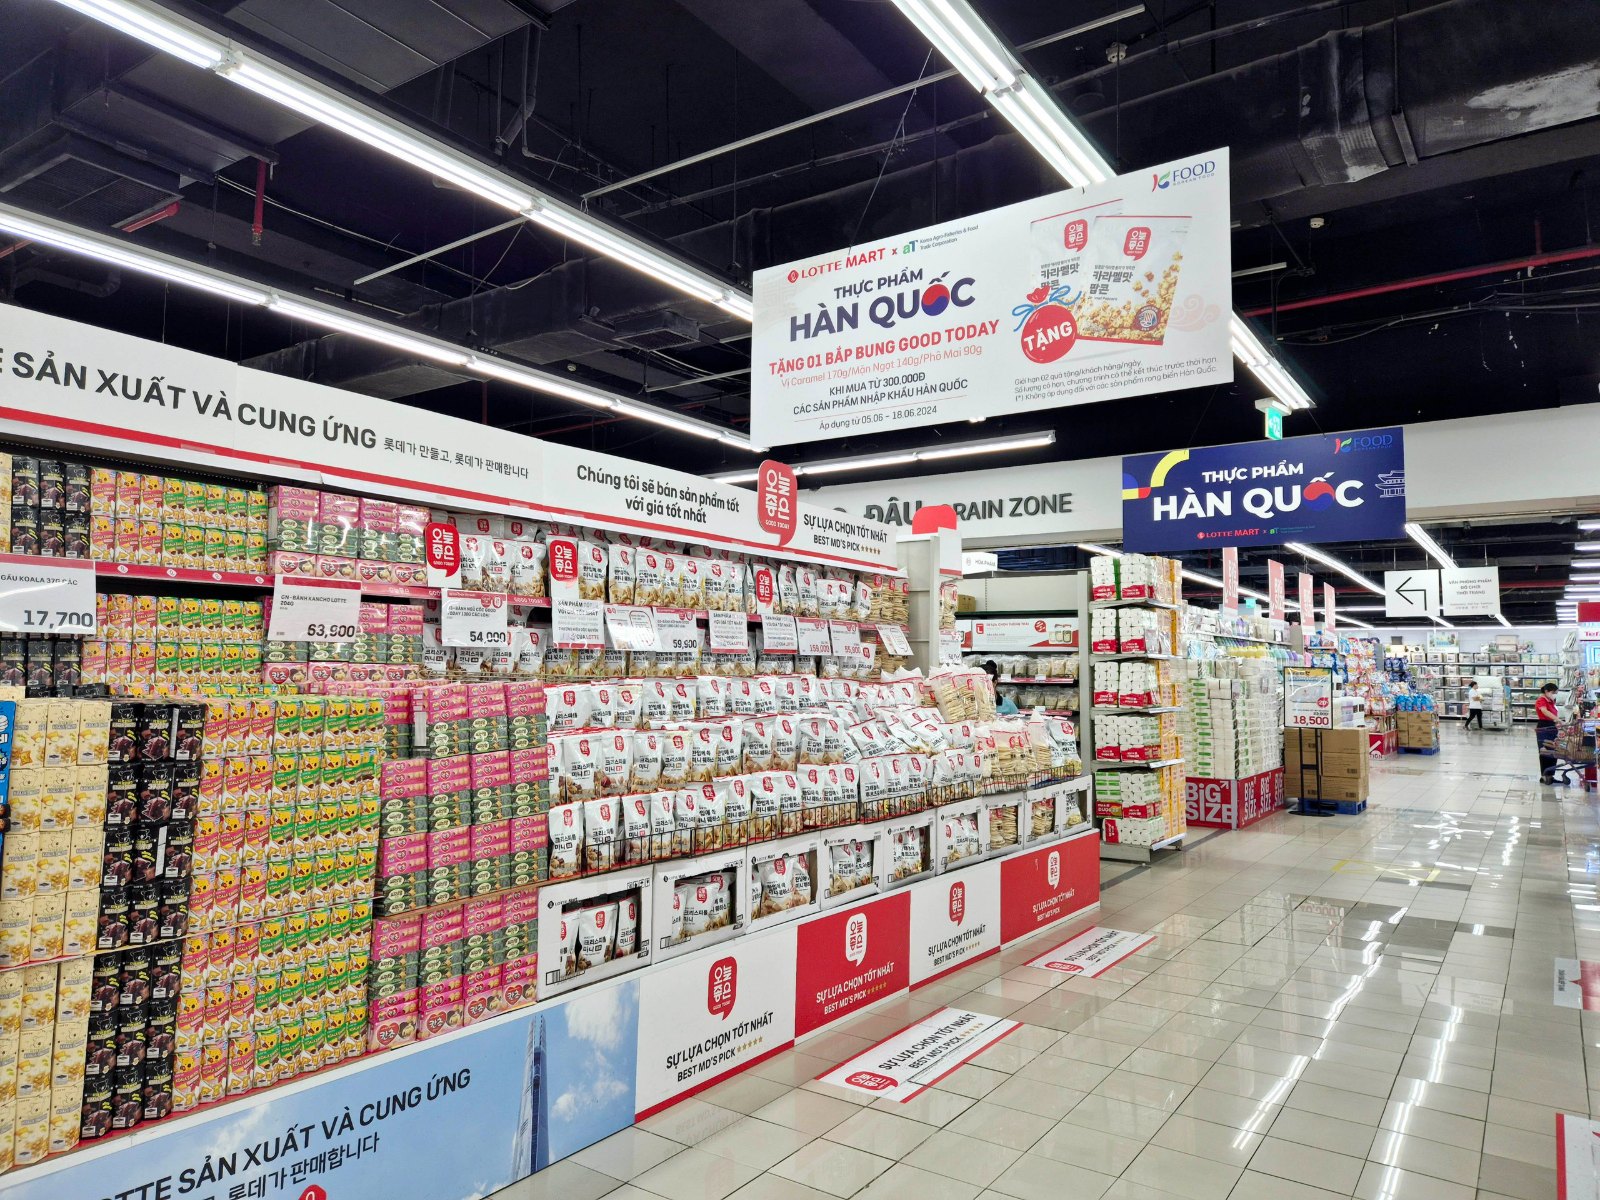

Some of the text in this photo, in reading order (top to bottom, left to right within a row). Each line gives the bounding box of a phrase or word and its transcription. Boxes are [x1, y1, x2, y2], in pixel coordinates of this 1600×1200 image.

[801, 261, 842, 279] LOTTE
[845, 248, 886, 268] MART
[968, 224, 979, 232] Food
[834, 267, 923, 299] THỰC PHẨM
[1093, 271, 1133, 282] 카라멜맛
[790, 270, 976, 342] HÀN QUỐC
[769, 320, 999, 377] TẶNG 01 BẮP BUNG GOOD TODAY
[1024, 322, 1073, 351] TẶNG
[781, 379, 790, 389] Vị
[791, 372, 825, 387] Caramel
[873, 362, 894, 375] Ngọt
[896, 350, 942, 369] 140g/Phô
[944, 349, 962, 360] Mai
[964, 345, 982, 359] 90g
[12, 351, 87, 390] SẢN
[96, 369, 187, 409] XUẤT
[193, 390, 233, 421] VÀ
[238, 403, 316, 438] CUNG
[322, 415, 377, 449] ỨNG
[793, 379, 968, 415] CÁC SẢN PHẨM NHẬP KHẨU HÀN QUỐC
[830, 372, 926, 396] KHI MUA TỪ 300.000Đ
[820, 420, 829, 431] Áp
[831, 417, 850, 431] dụng
[851, 417, 860, 427] từ
[861, 413, 883, 425] 05.06
[892, 405, 937, 421] 18.06.2024
[384, 437, 529, 479] 롯데가 만들고, 롯데가 판매합니다
[1202, 460, 1304, 485] THỰC PHẨM
[577, 464, 739, 512] Chúng tôi sẽ bán sản phẩm tốt
[1153, 471, 1364, 521] HÀN QUỐC
[625, 497, 707, 524] với giá tốt nhất
[954, 498, 1002, 521] RAIN
[1009, 492, 1072, 518] ZONE
[803, 513, 888, 544] SỰ LỰA CHỌN TỐT NHẤT
[813, 534, 861, 552] BEST MD'S PICK
[1234, 528, 1260, 536] MART
[24, 610, 93, 629] 17,700
[308, 624, 355, 638] 63,900
[1294, 716, 1329, 726] 18,500
[666, 1012, 774, 1070] SỰ LỰA CHỌN TỐT NHẤT
[677, 1048, 736, 1082] BEST MD'S PICK
[179, 1068, 471, 1193] SẢN XUẤT VÀ CUNG ỨNG
[292, 1131, 381, 1185] 판매합니다
